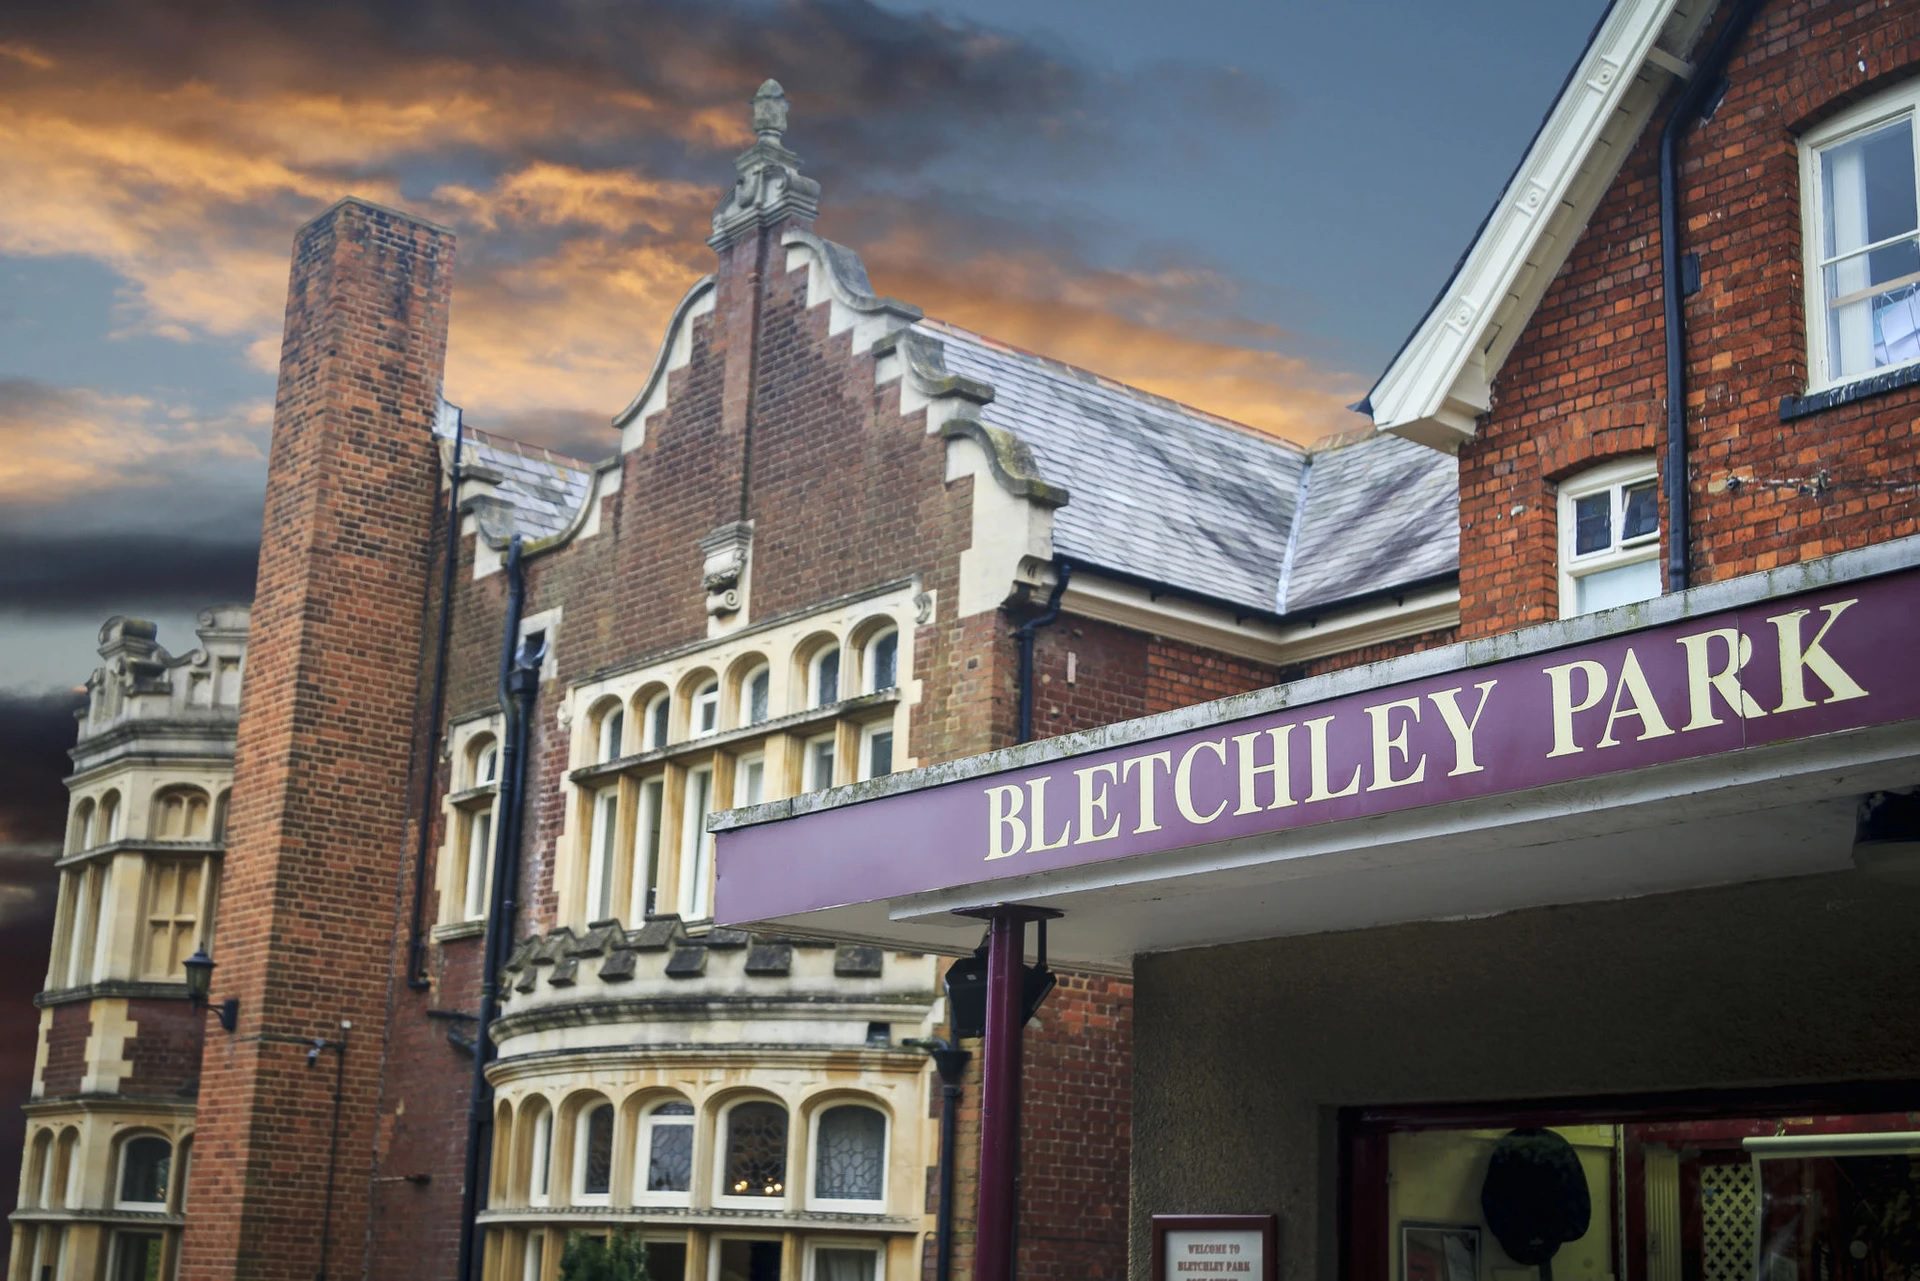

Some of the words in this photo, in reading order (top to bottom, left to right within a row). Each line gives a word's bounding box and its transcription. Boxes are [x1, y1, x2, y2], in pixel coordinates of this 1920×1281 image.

[984, 680, 1498, 862] BLETCHLEY
[1542, 598, 1869, 758] PARK
[1188, 1244, 1227, 1254] WELCOME
[1229, 1244, 1240, 1254] TO
[1177, 1261, 1224, 1271] BLETCHLEY
[1226, 1261, 1250, 1271] PARK
